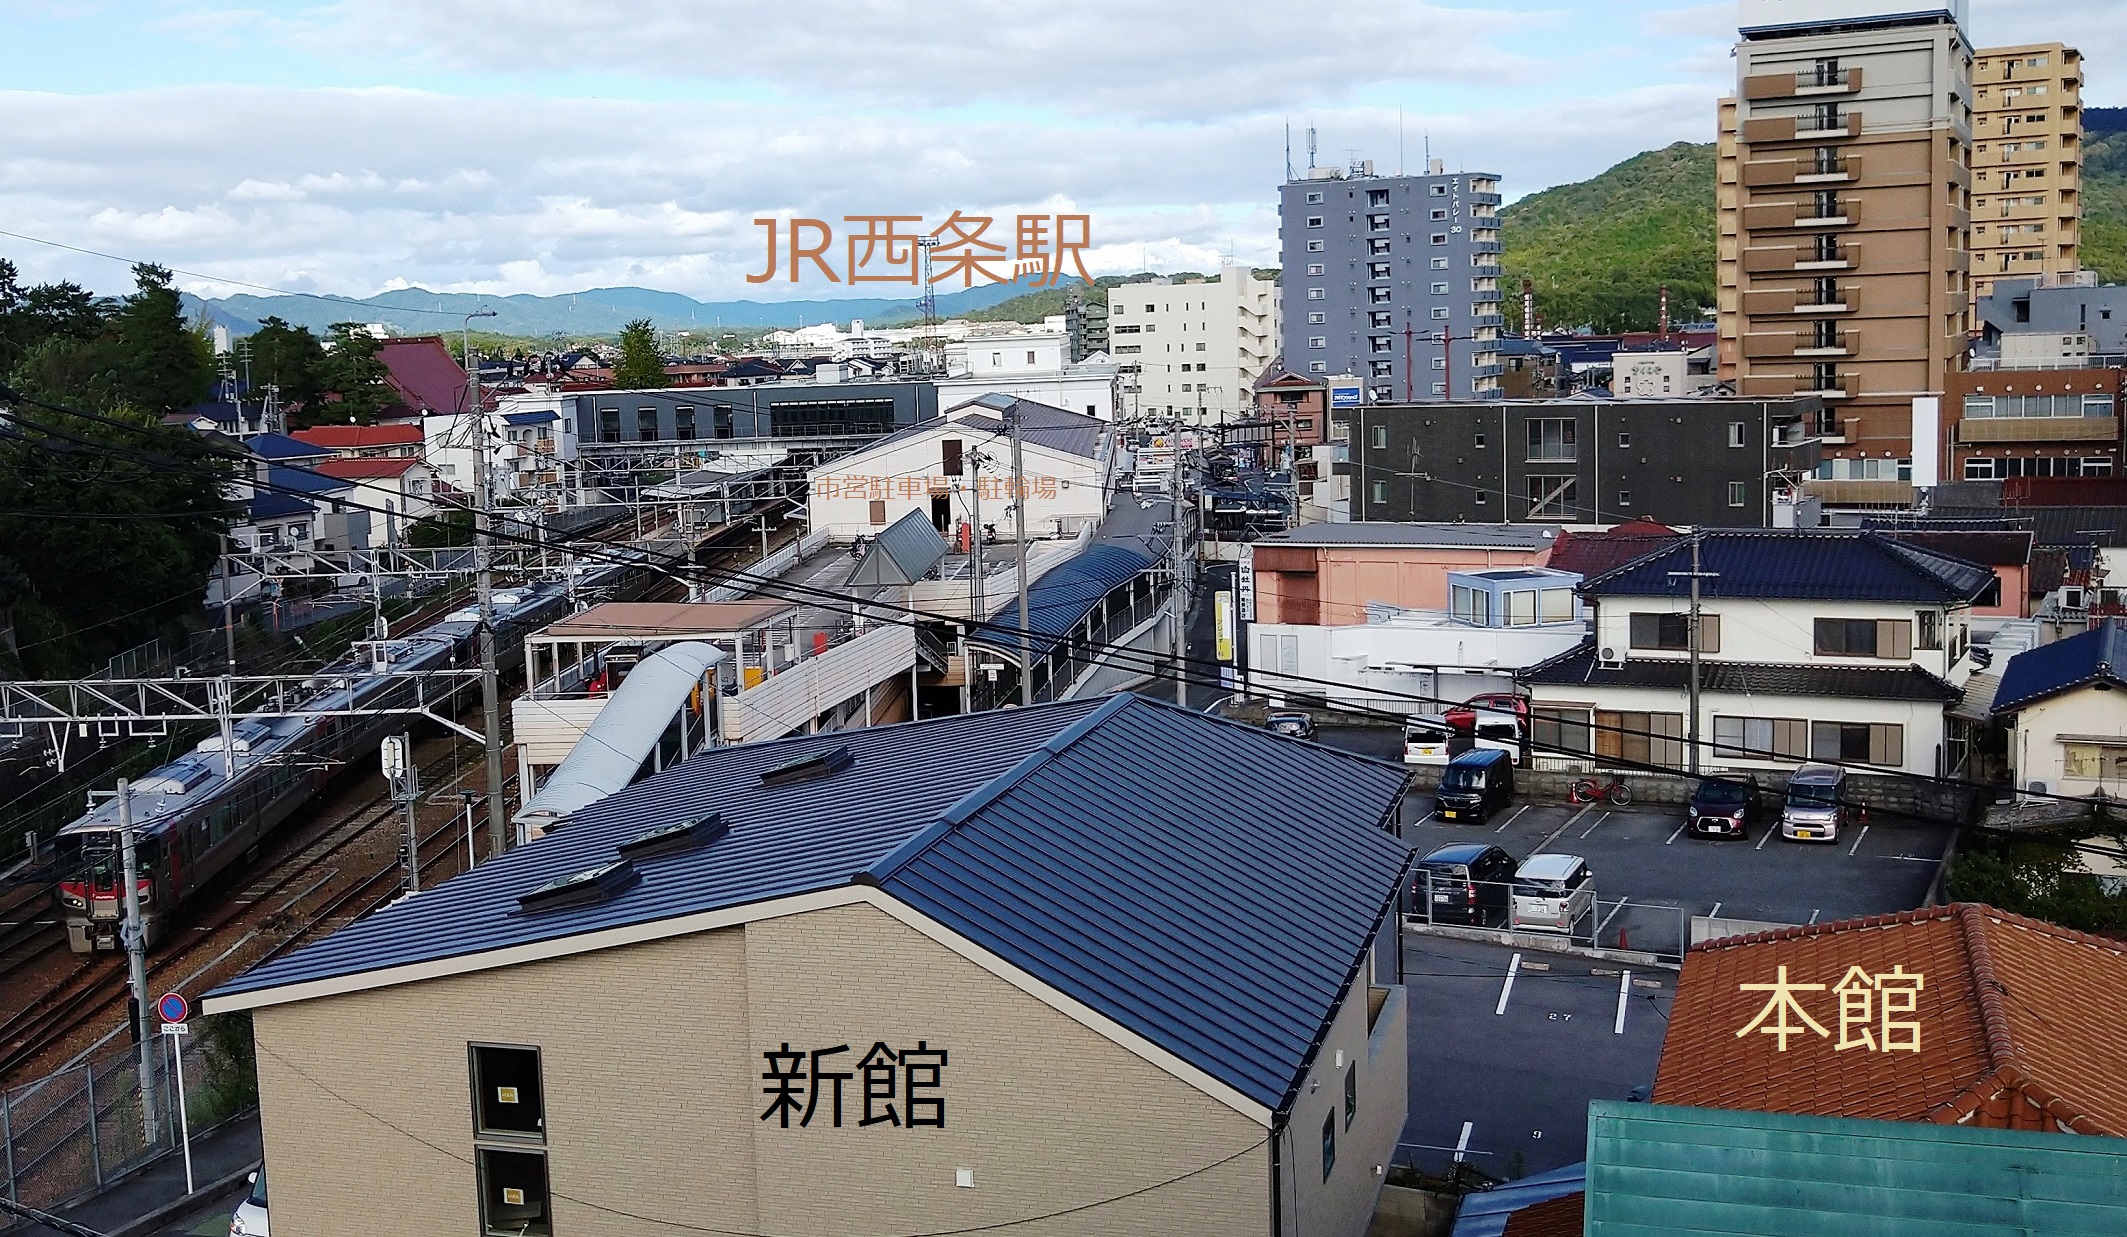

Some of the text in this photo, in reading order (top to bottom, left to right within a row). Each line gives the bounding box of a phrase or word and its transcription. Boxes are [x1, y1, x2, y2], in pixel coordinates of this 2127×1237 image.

[1450, 226, 1462, 234] 30
[1548, 1012, 1572, 1021] 27
[1532, 1130, 1542, 1139] 9
